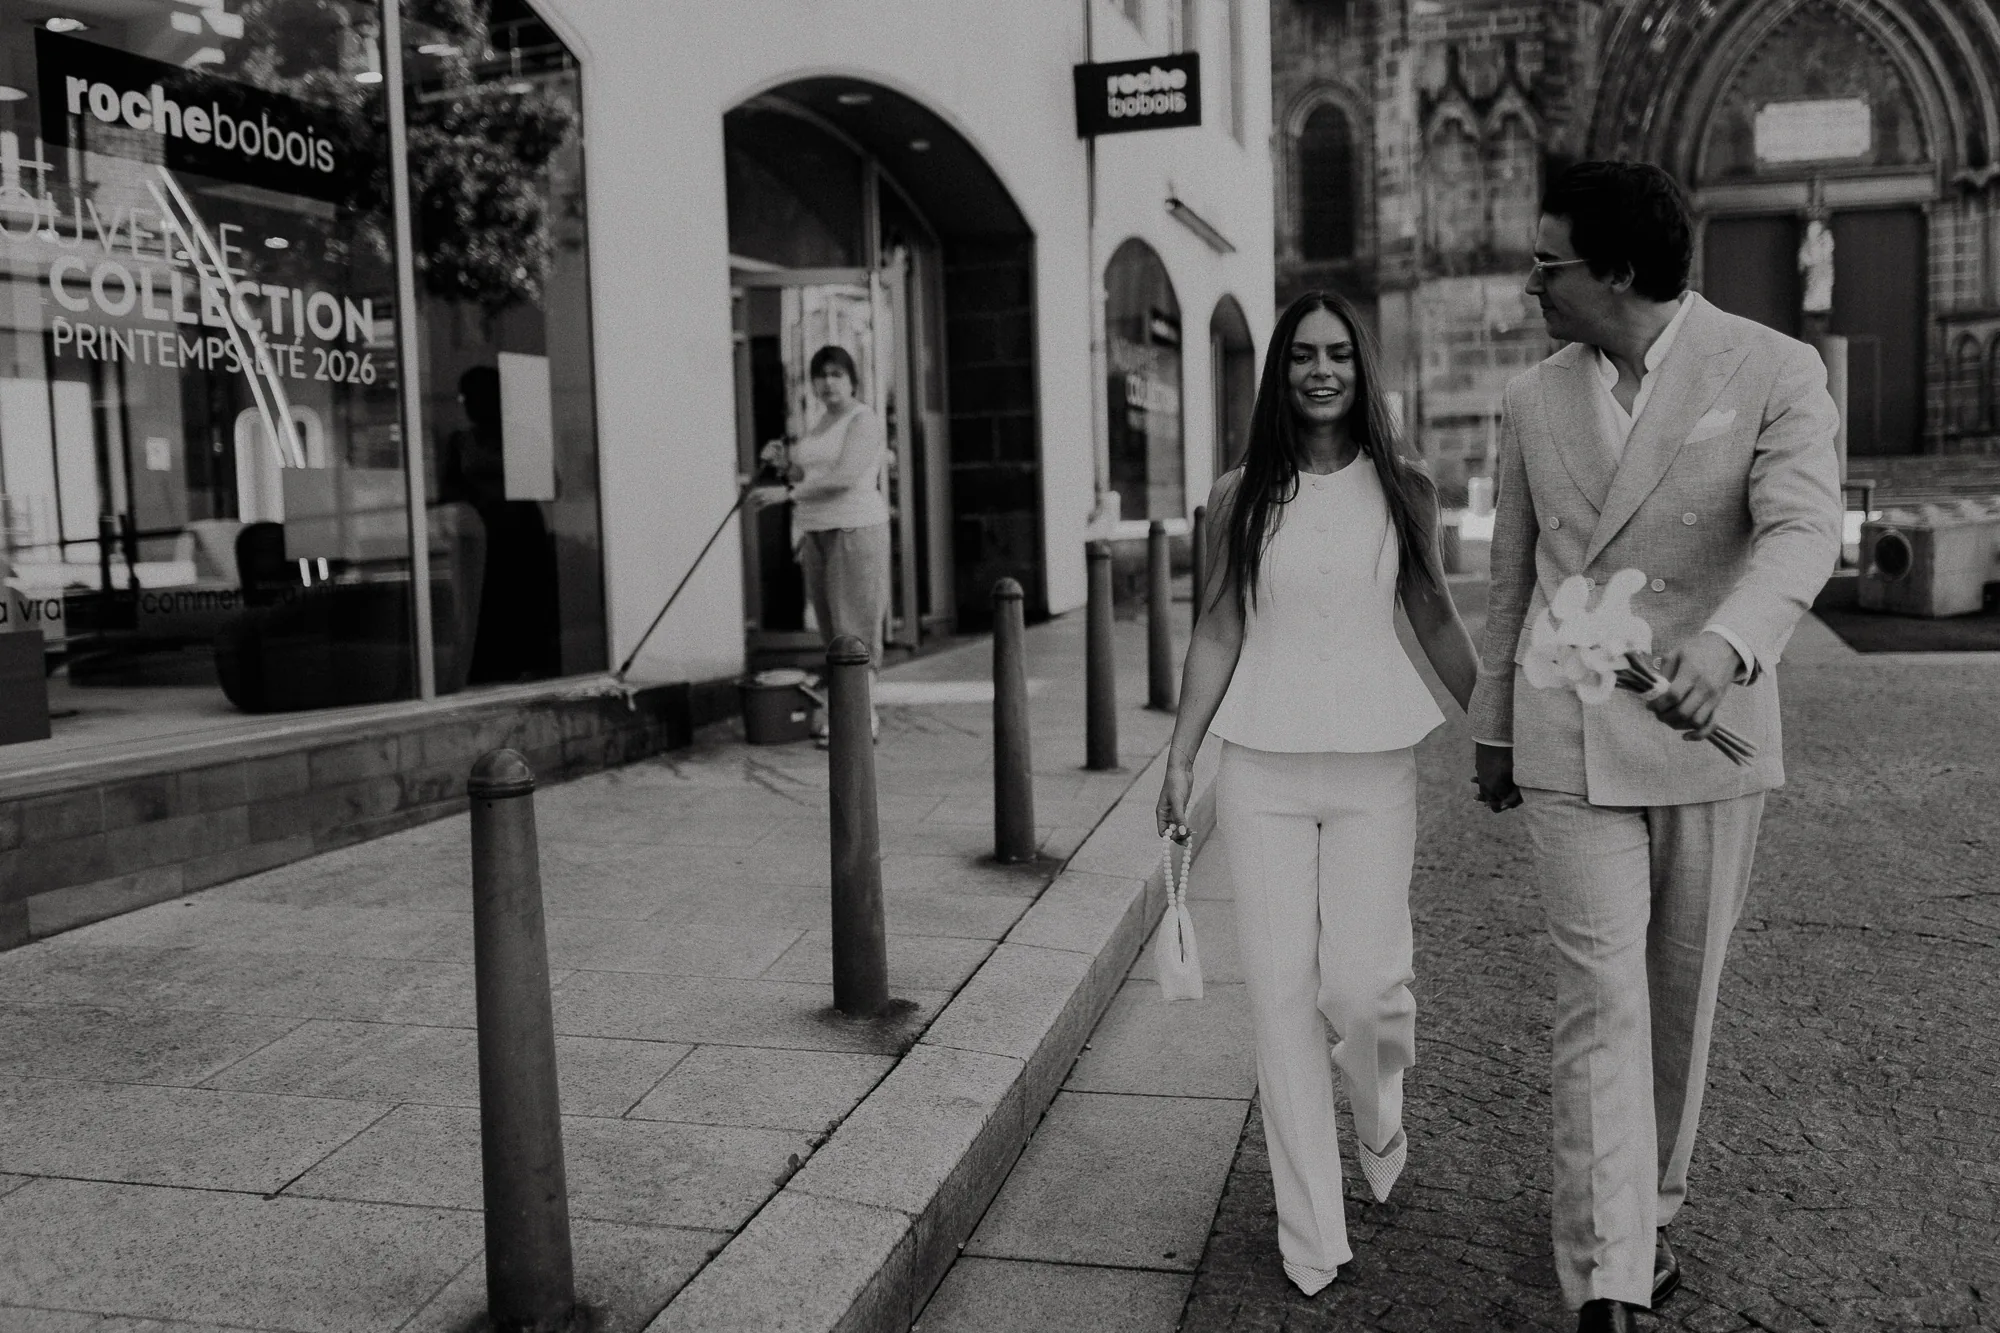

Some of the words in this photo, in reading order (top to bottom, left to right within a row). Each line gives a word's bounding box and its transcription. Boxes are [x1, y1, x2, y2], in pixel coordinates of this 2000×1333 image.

[66, 75, 335, 173] rochebobois
[1107, 91, 1188, 118] bobois
[0, 185, 247, 277] OUVELLE
[50, 254, 374, 345] COLLECTION
[312, 348, 376, 385] 2026
